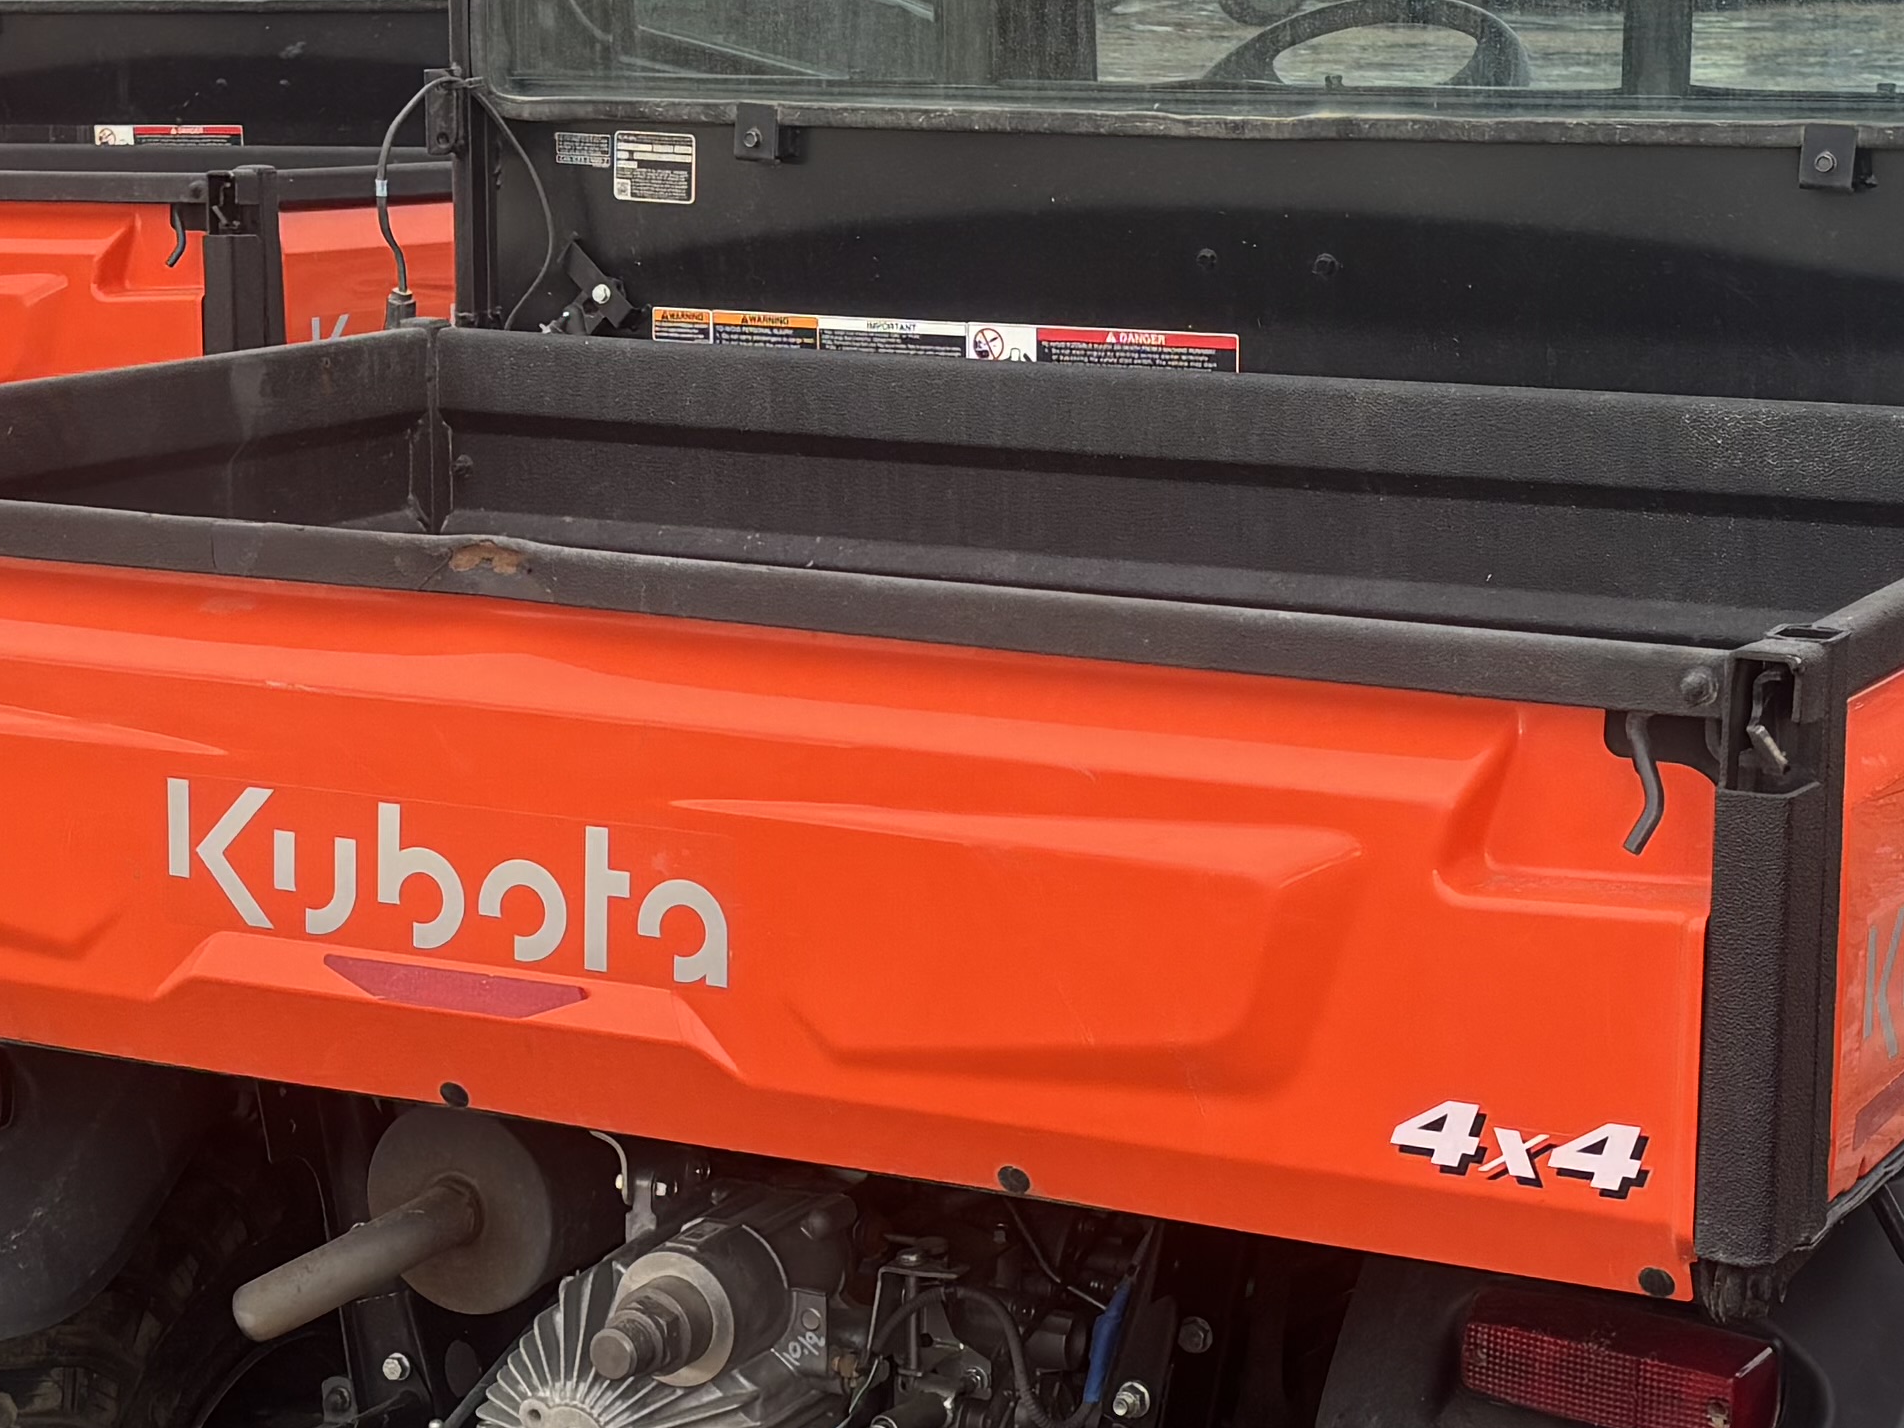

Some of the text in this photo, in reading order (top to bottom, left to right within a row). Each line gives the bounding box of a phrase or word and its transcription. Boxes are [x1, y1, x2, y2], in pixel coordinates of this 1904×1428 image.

[866, 321, 916, 332] IMPORTANT
[1119, 333, 1166, 345] DANGER
[167, 777, 728, 988] Kubota
[1390, 1100, 1652, 1200] 4x4
